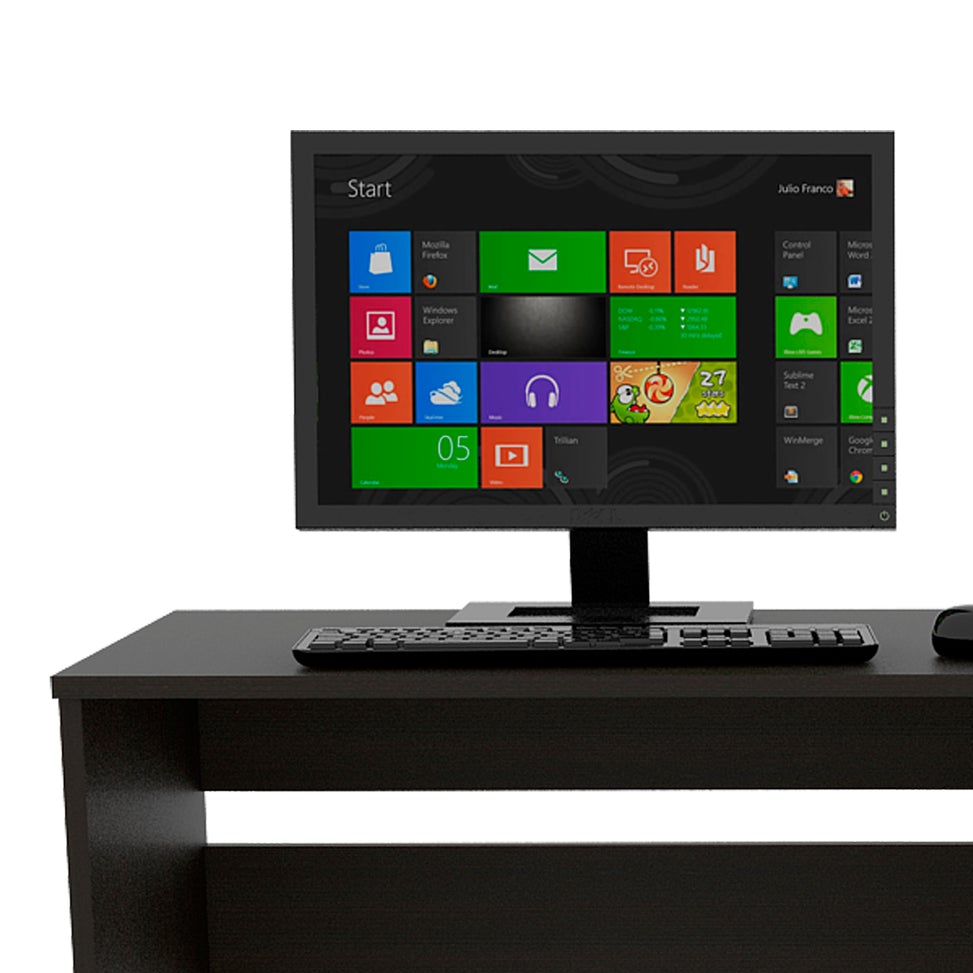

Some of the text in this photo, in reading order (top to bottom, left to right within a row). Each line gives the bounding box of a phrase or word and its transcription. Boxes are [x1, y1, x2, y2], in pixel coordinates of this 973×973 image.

[347, 178, 393, 198] Start
[777, 183, 834, 194] Julio Franco
[421, 240, 450, 250] Mozilla
[782, 240, 812, 250] Control
[421, 251, 448, 260] Firefox
[782, 250, 804, 260] Panel
[847, 250, 869, 260] Word
[422, 306, 458, 315] Windows
[422, 316, 454, 326] Explorer
[847, 315, 867, 325] Excel
[699, 369, 727, 388] 27
[783, 371, 814, 380] Sublime
[783, 381, 806, 390] Text 2
[554, 436, 579, 445] Trillian
[783, 436, 824, 446] WinMerge
[437, 434, 471, 461] 05
